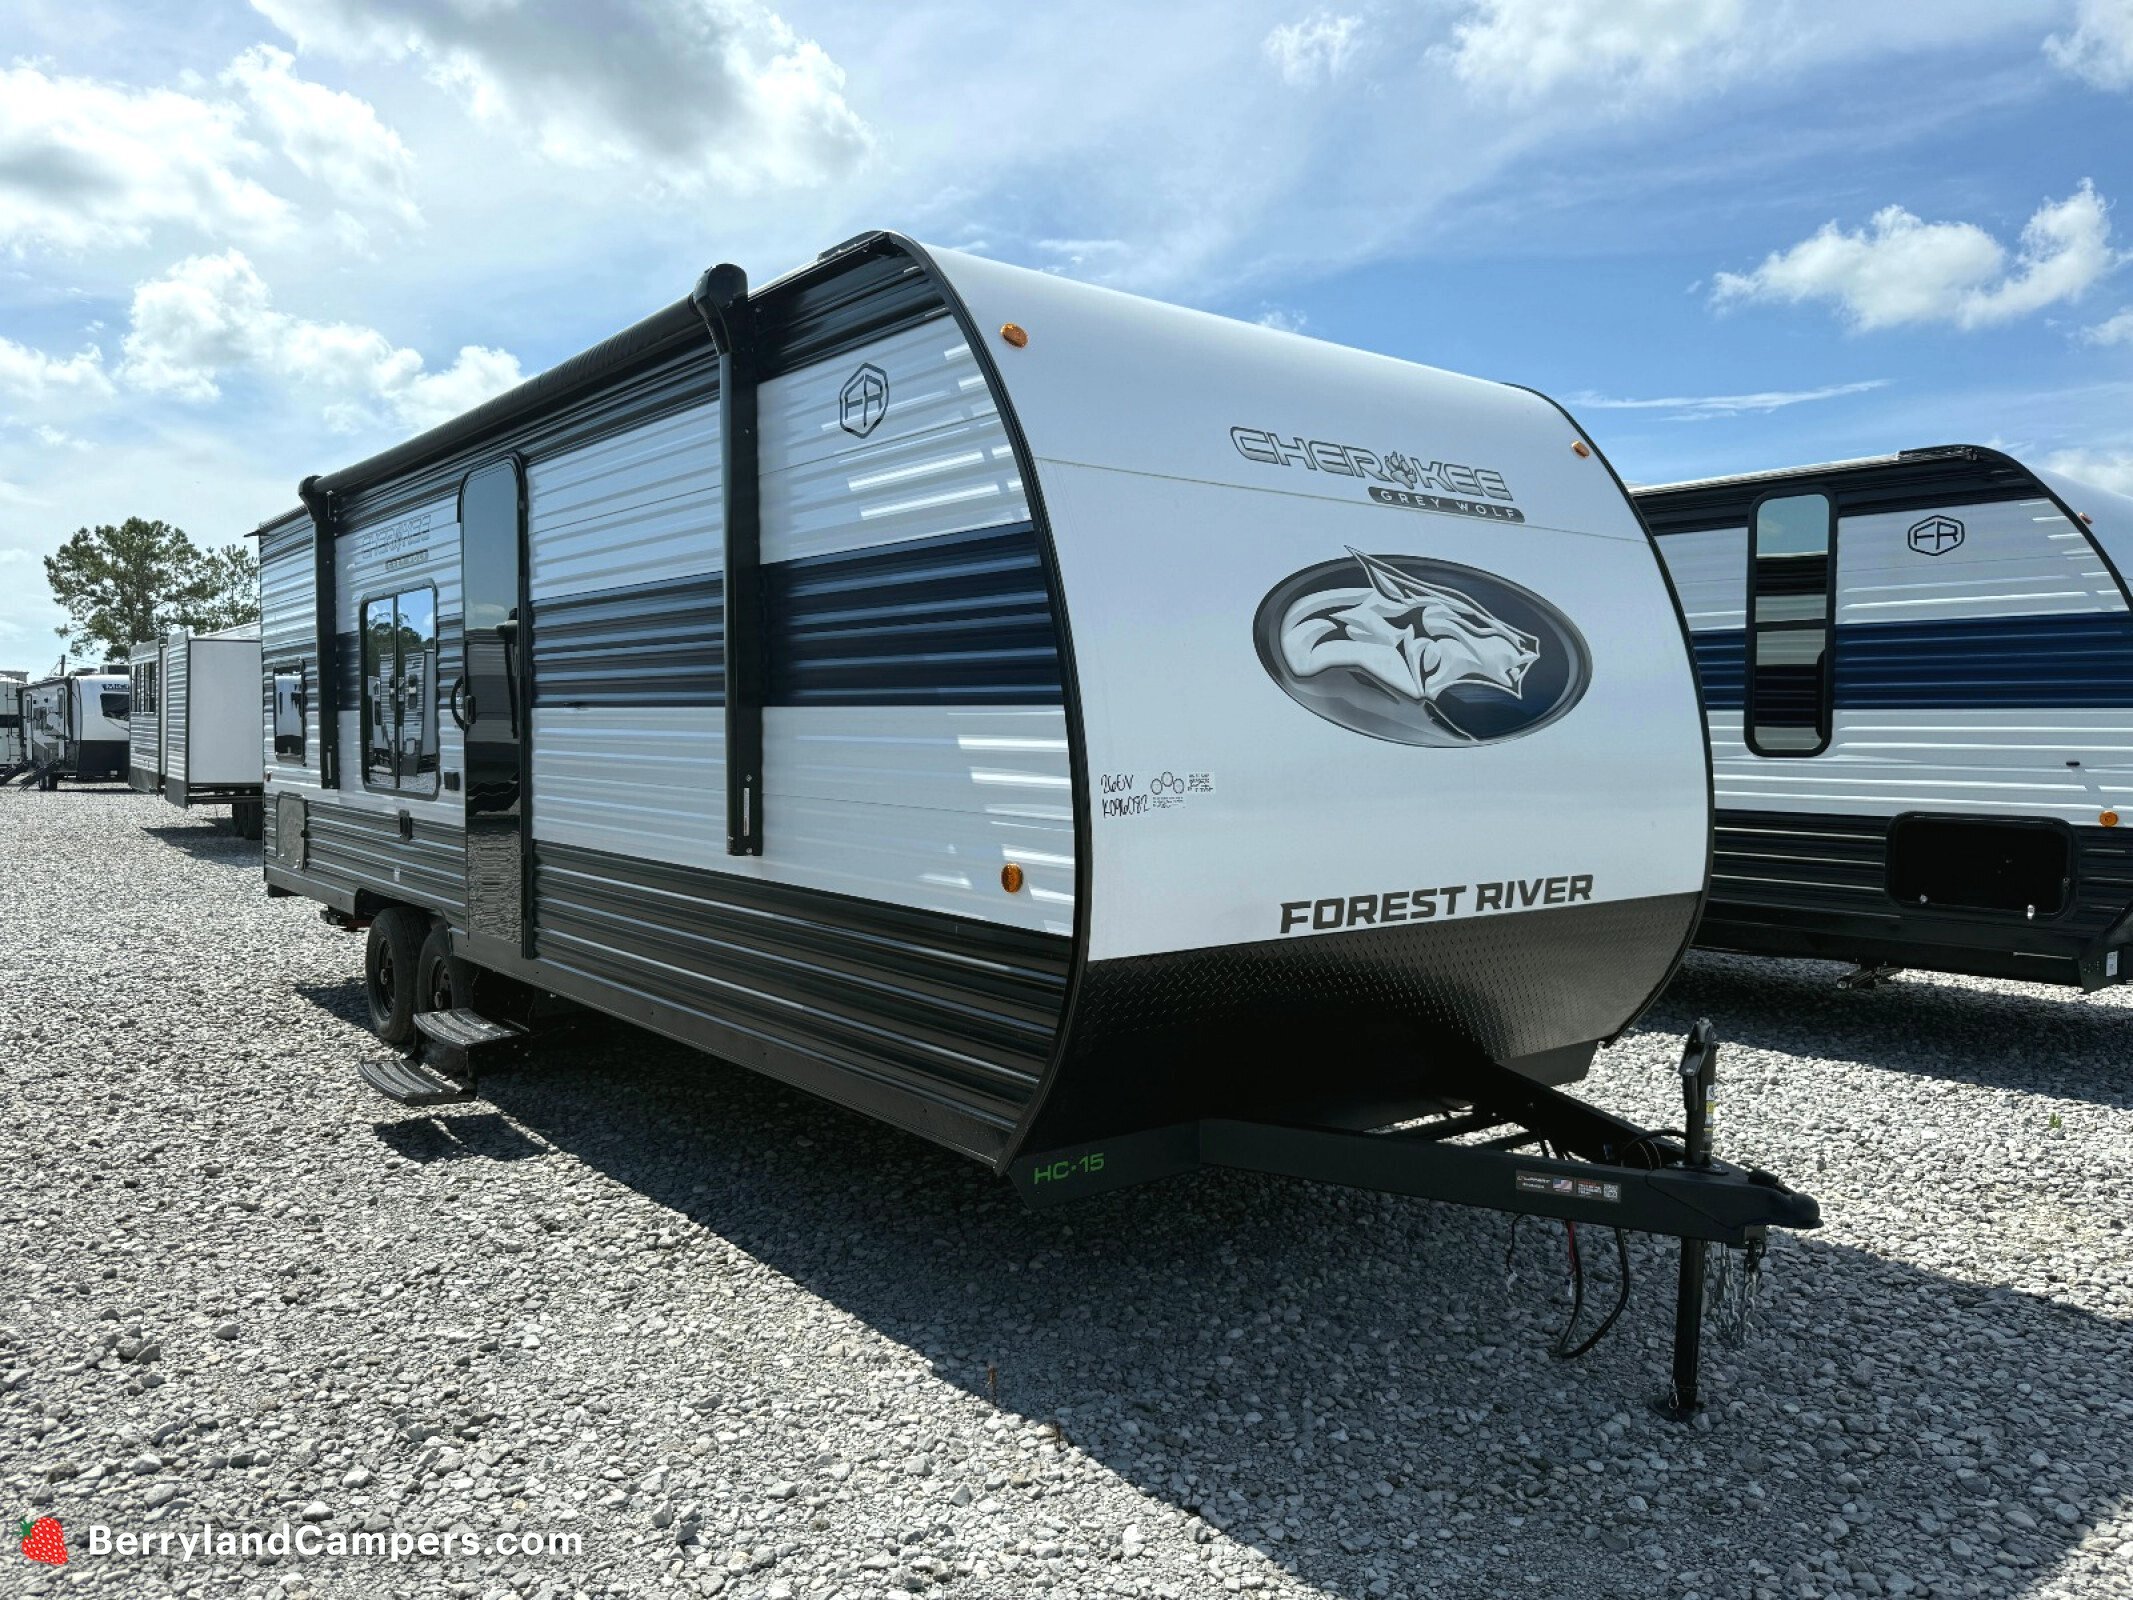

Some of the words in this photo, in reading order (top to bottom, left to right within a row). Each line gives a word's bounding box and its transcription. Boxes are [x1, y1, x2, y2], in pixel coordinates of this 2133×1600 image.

[1380, 489, 1441, 509] GREY
[1455, 501, 1515, 519] WOLF
[1279, 885, 1467, 934] FOREST
[1476, 874, 1594, 912] RIVER
